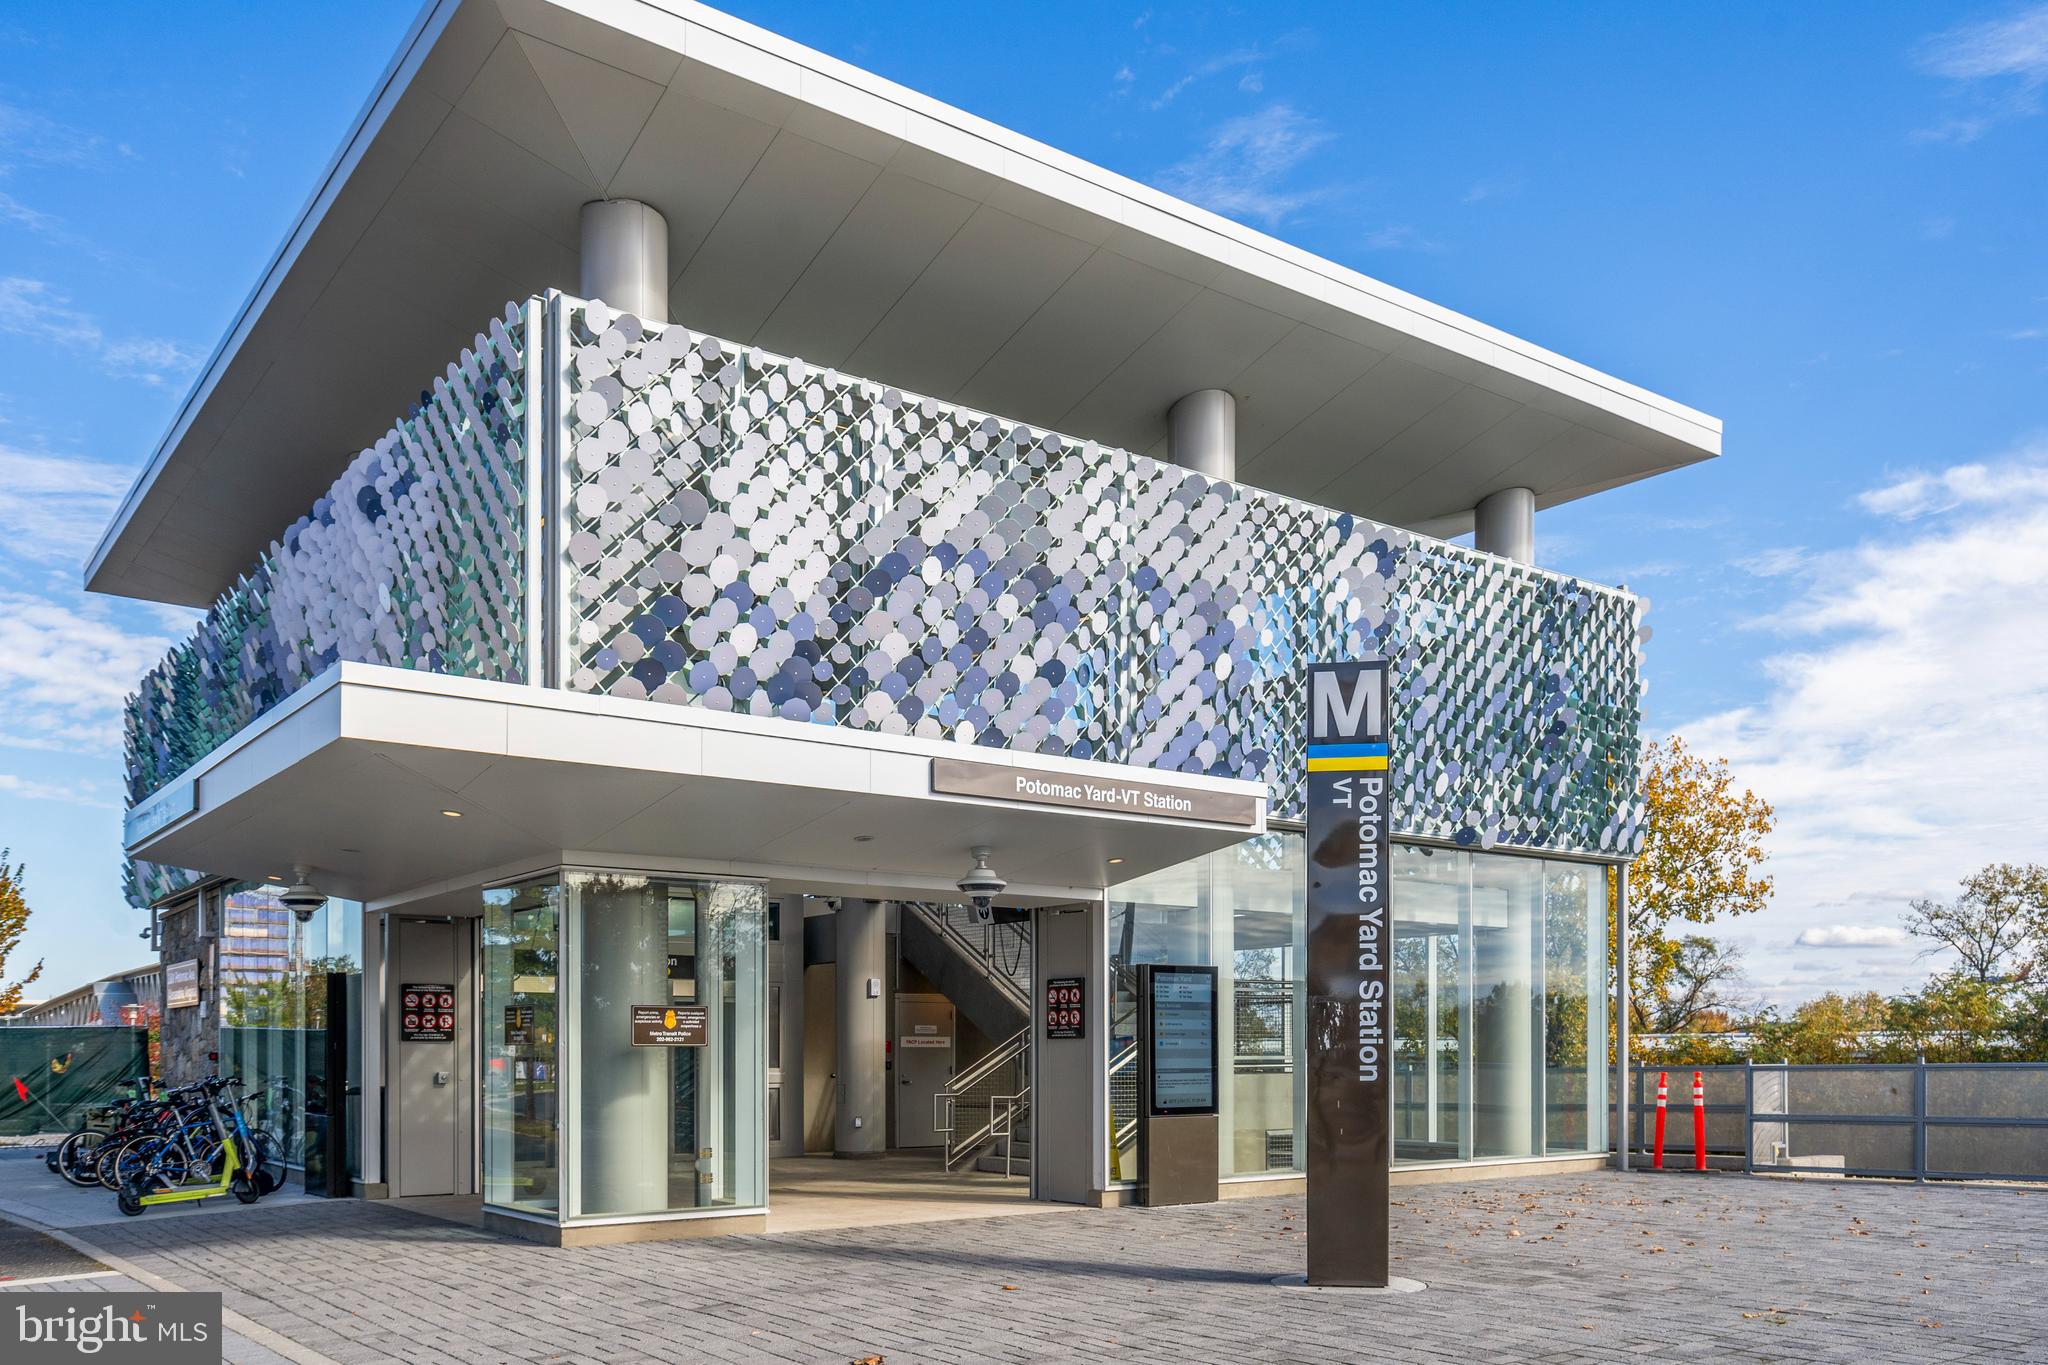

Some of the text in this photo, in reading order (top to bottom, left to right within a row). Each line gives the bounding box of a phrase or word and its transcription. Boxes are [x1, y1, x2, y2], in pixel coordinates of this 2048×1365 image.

[1313, 669, 1382, 738] M
[1016, 776, 1192, 812] Potomac Yard-VT Station
[1332, 777, 1352, 809] VT
[1359, 777, 1384, 1082] Potomac Yard Station
